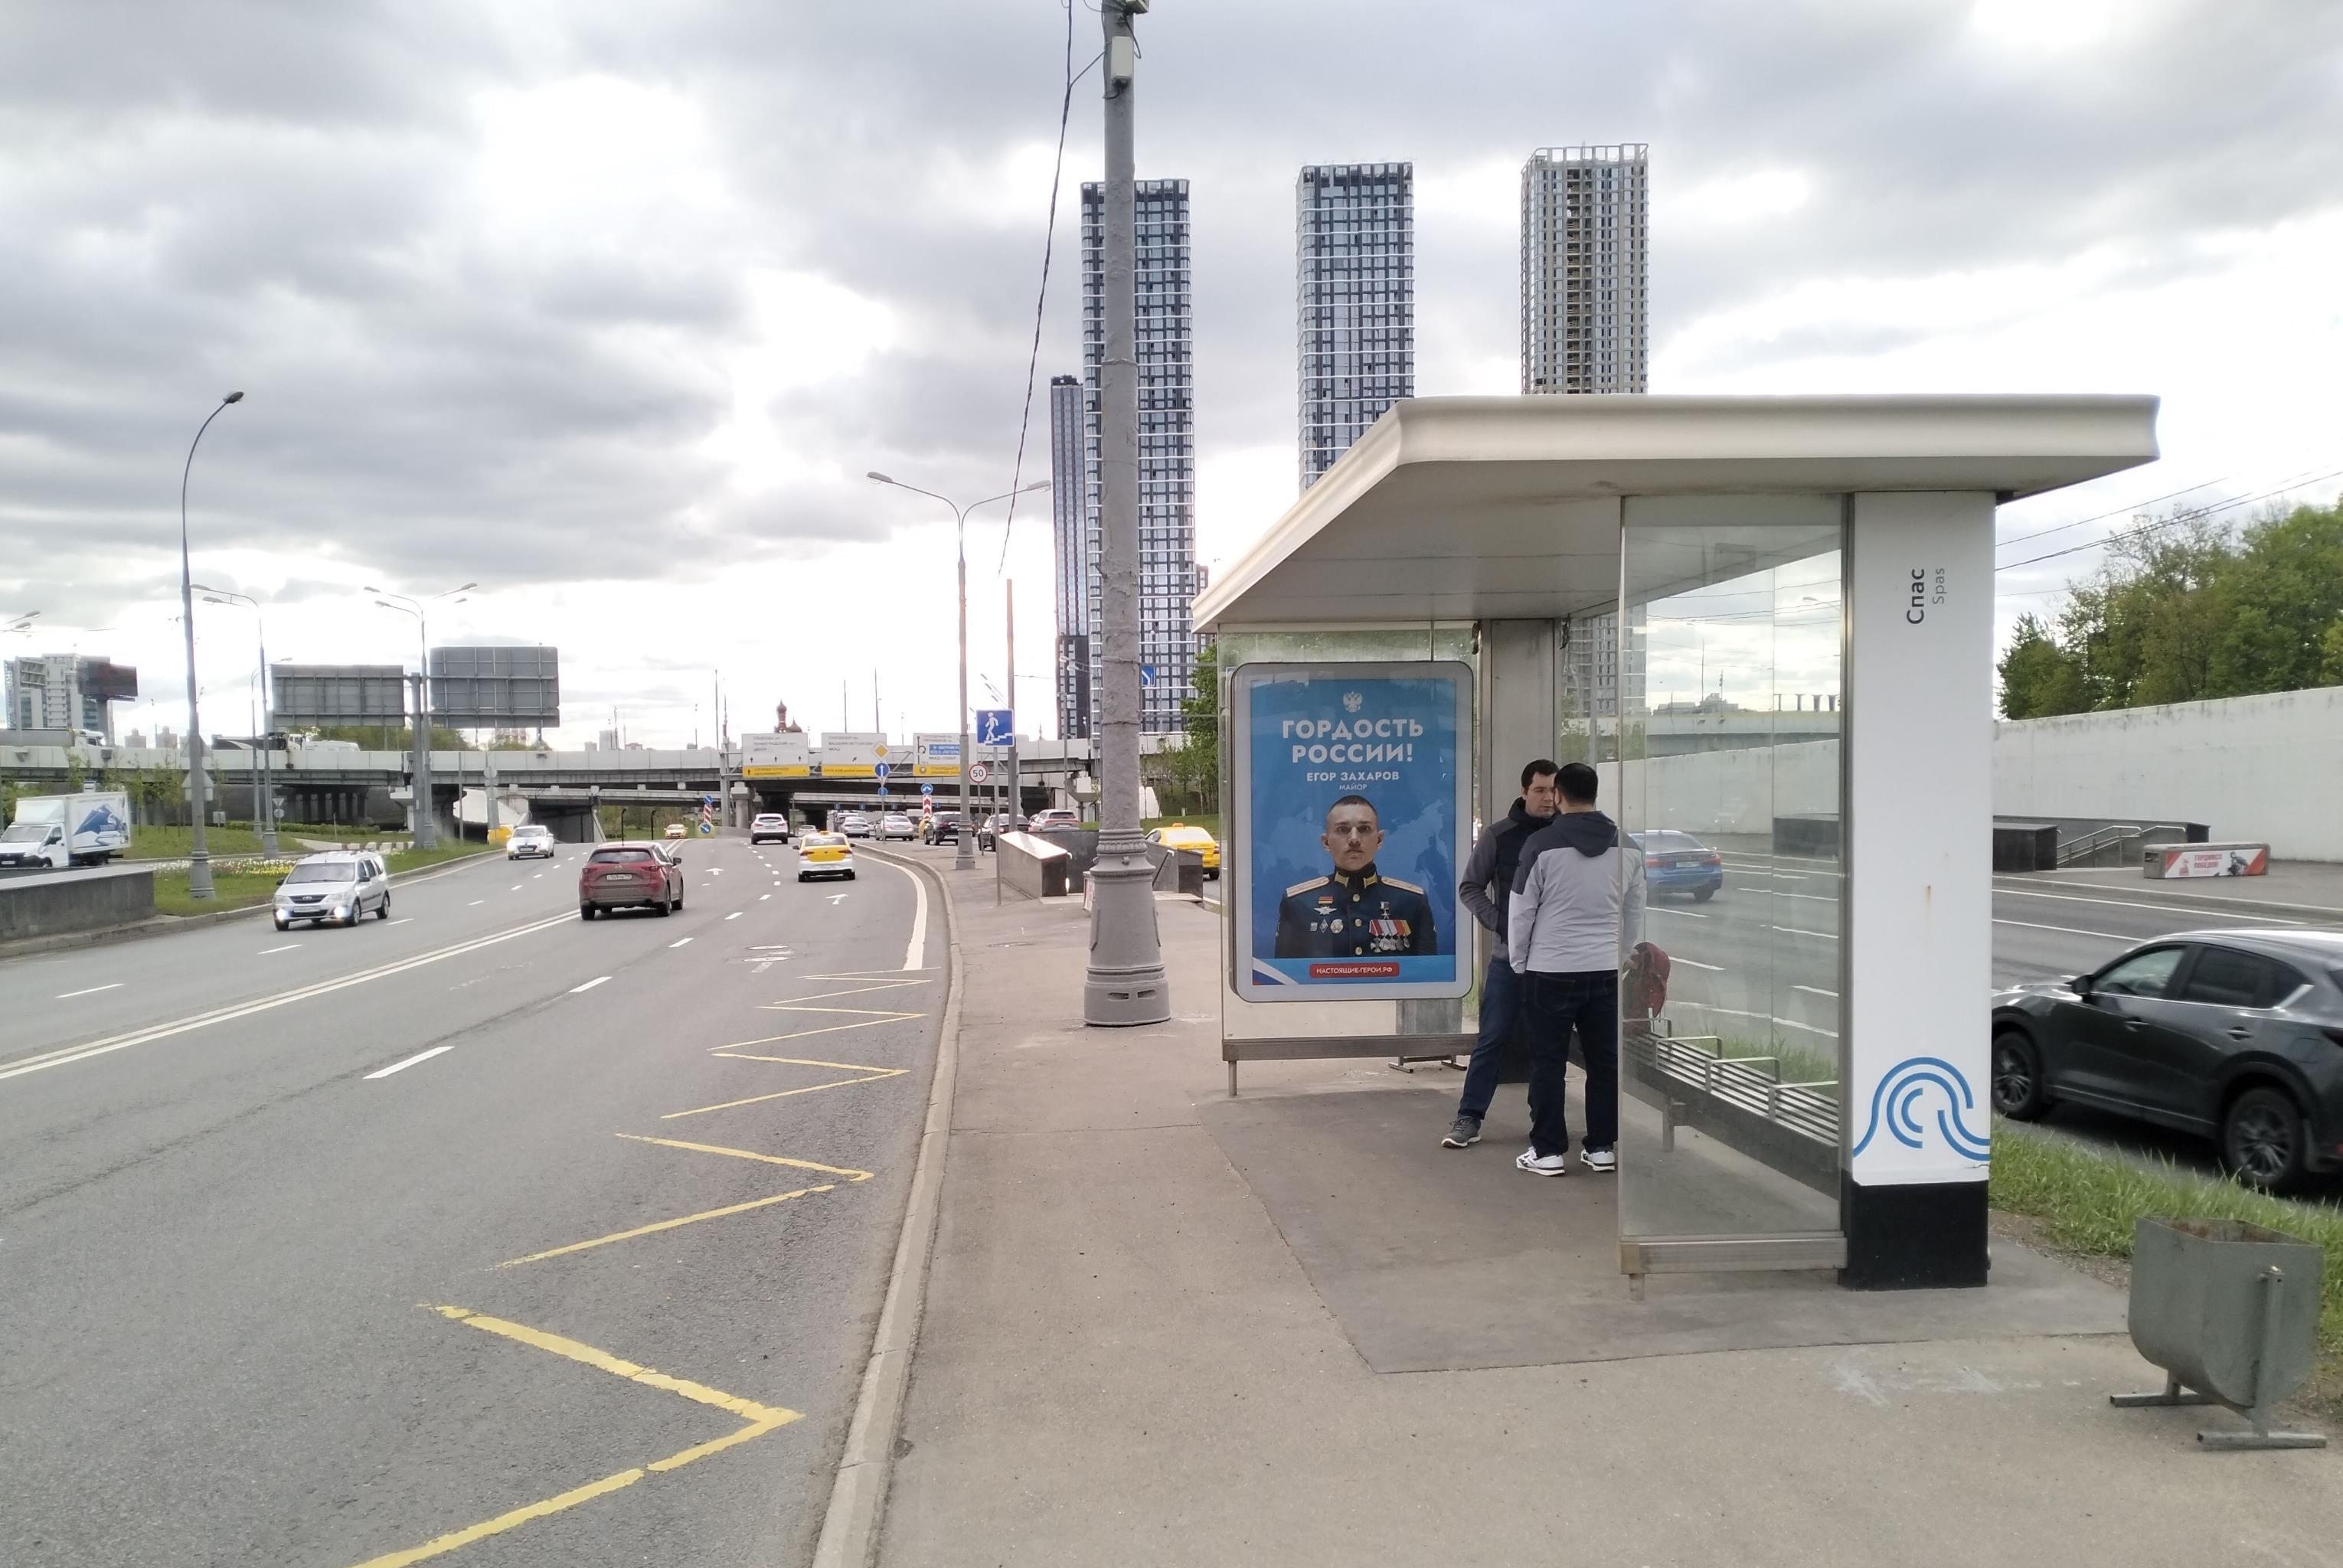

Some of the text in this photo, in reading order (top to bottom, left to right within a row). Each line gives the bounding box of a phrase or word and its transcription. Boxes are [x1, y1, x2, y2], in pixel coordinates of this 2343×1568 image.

[1907, 568, 1924, 624] Спас
[1932, 568, 1948, 605] Spas
[1283, 718, 1423, 740] ГОРДОСТЬ
[1292, 743, 1413, 763] РОССИИ!
[972, 769, 984, 778] 50
[1306, 771, 1400, 782] ЕГОР ЗАХАРОВ
[1338, 782, 1368, 791] МАЙОР
